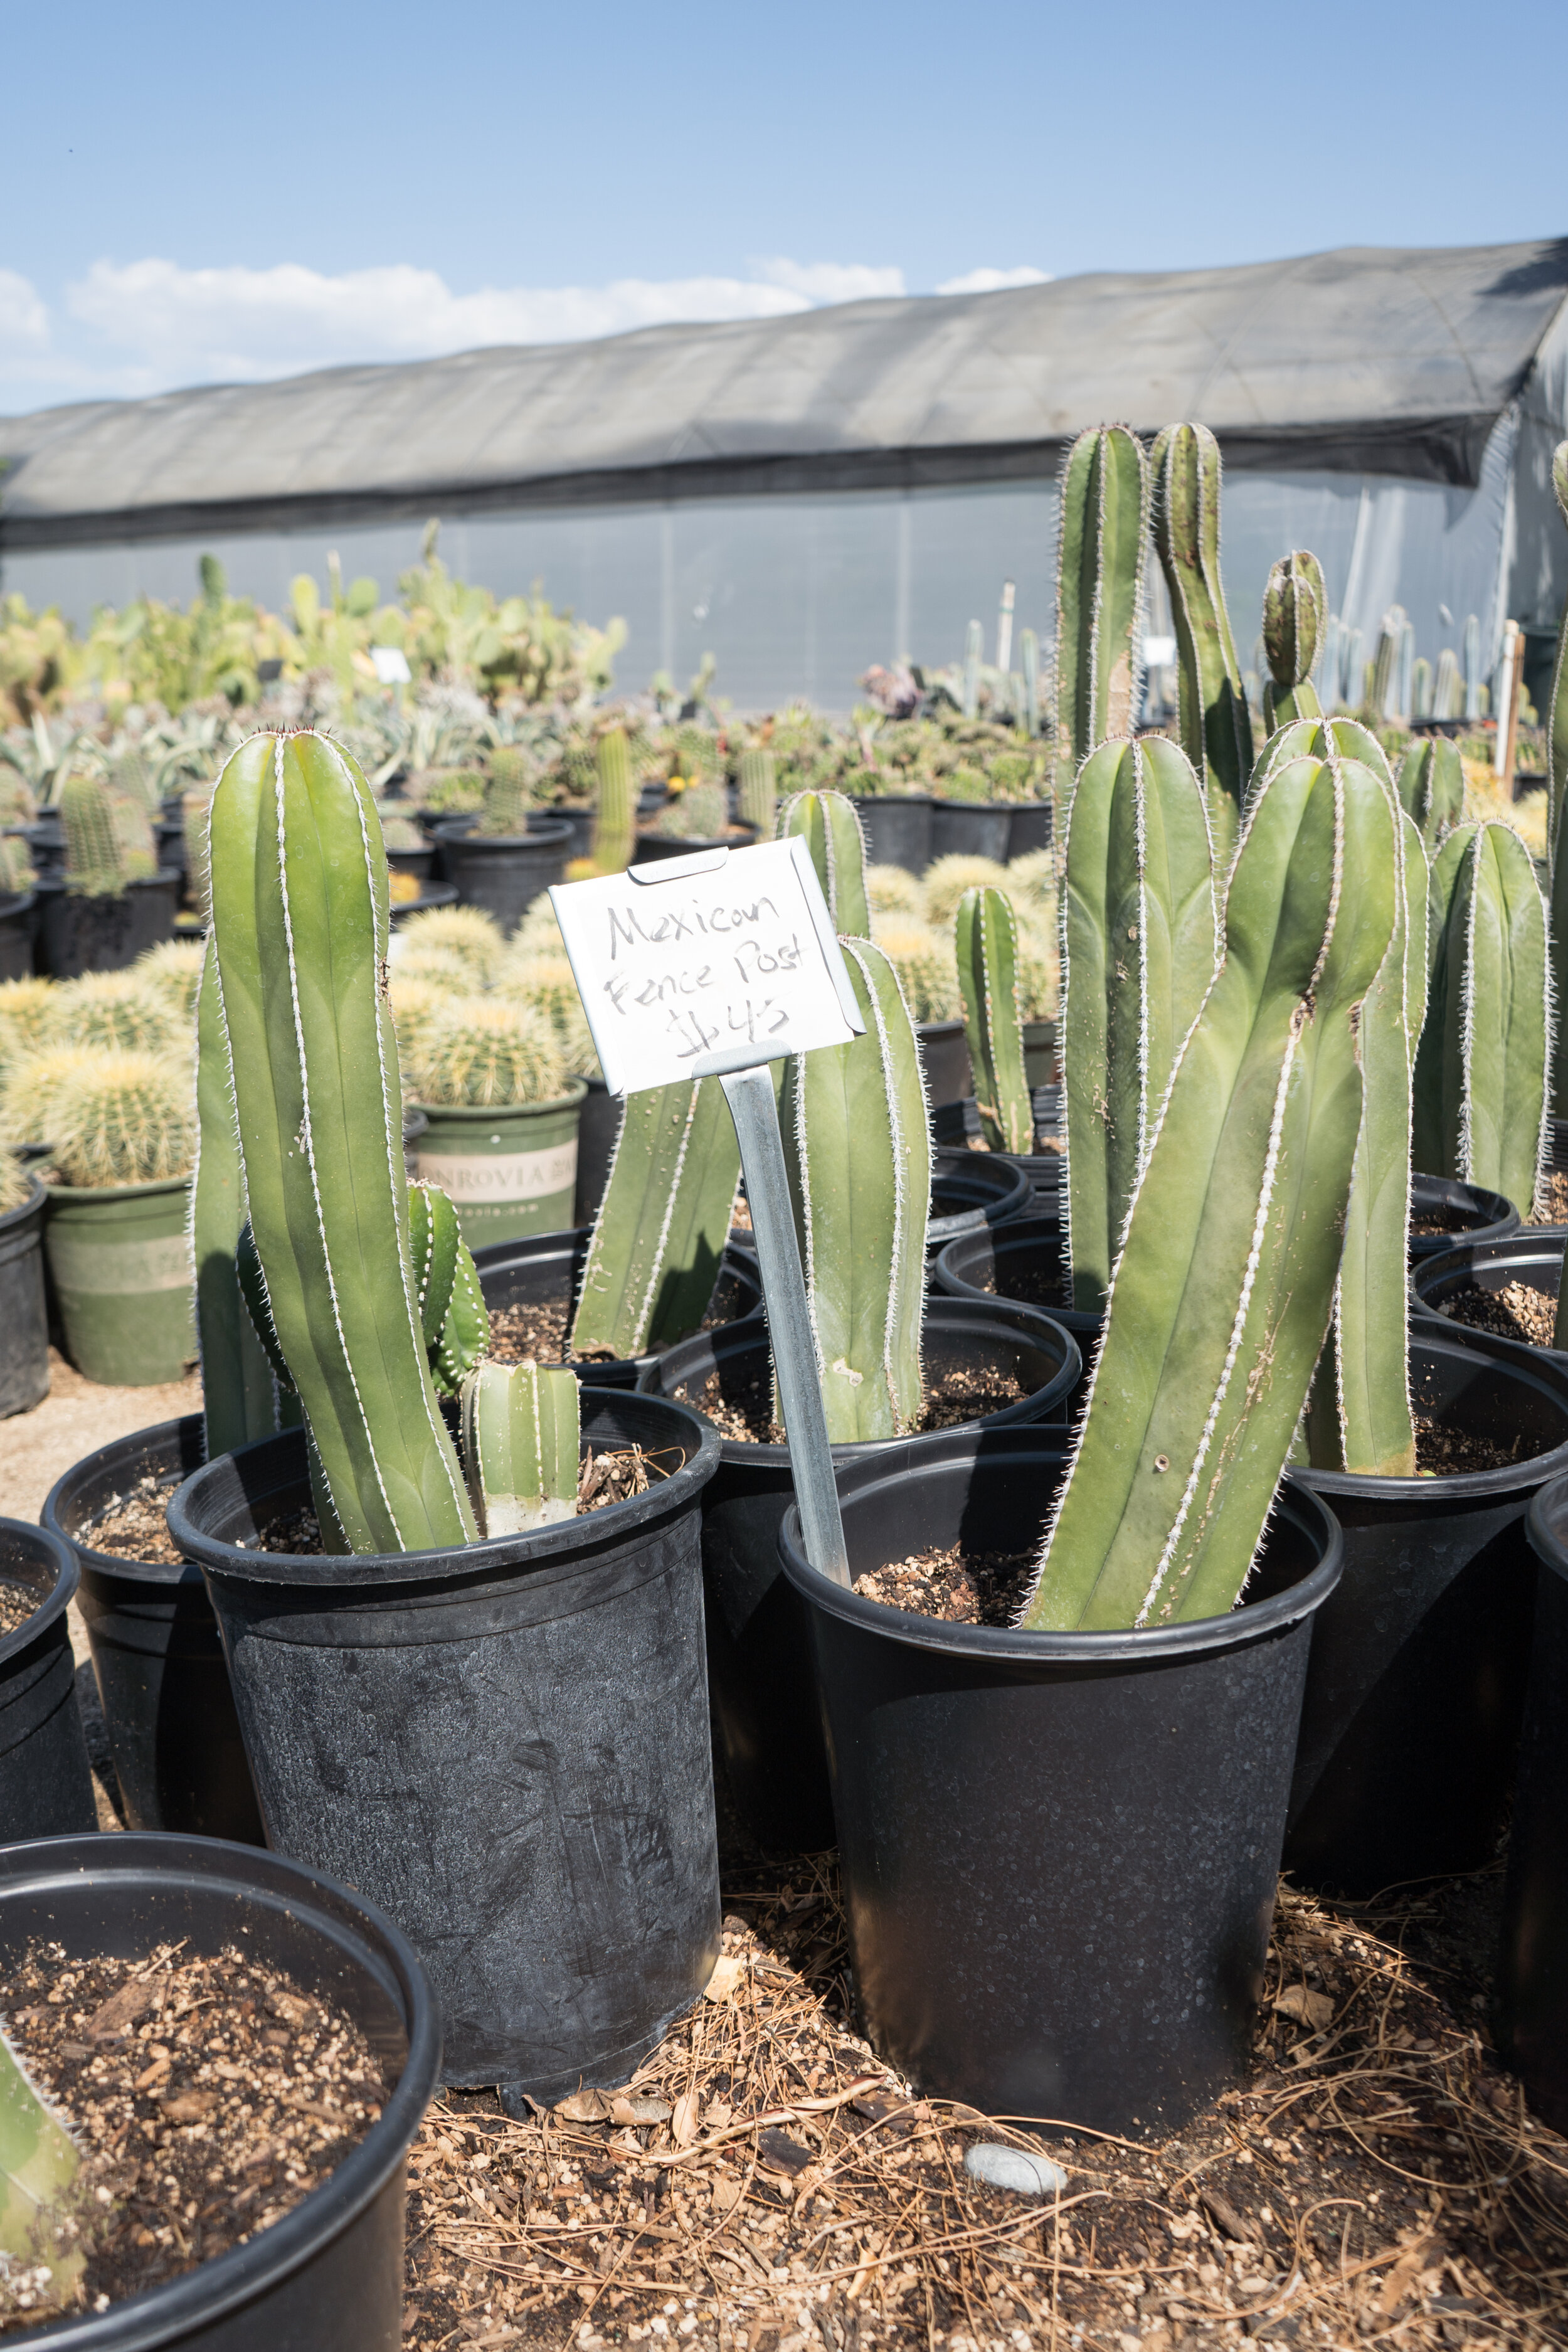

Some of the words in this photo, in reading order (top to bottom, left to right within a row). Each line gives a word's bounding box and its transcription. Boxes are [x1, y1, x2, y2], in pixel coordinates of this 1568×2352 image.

[607, 897, 780, 960] Mexican
[603, 965, 714, 1015] Fence
[734, 933, 805, 983] Post
[666, 998, 790, 1058] $45
